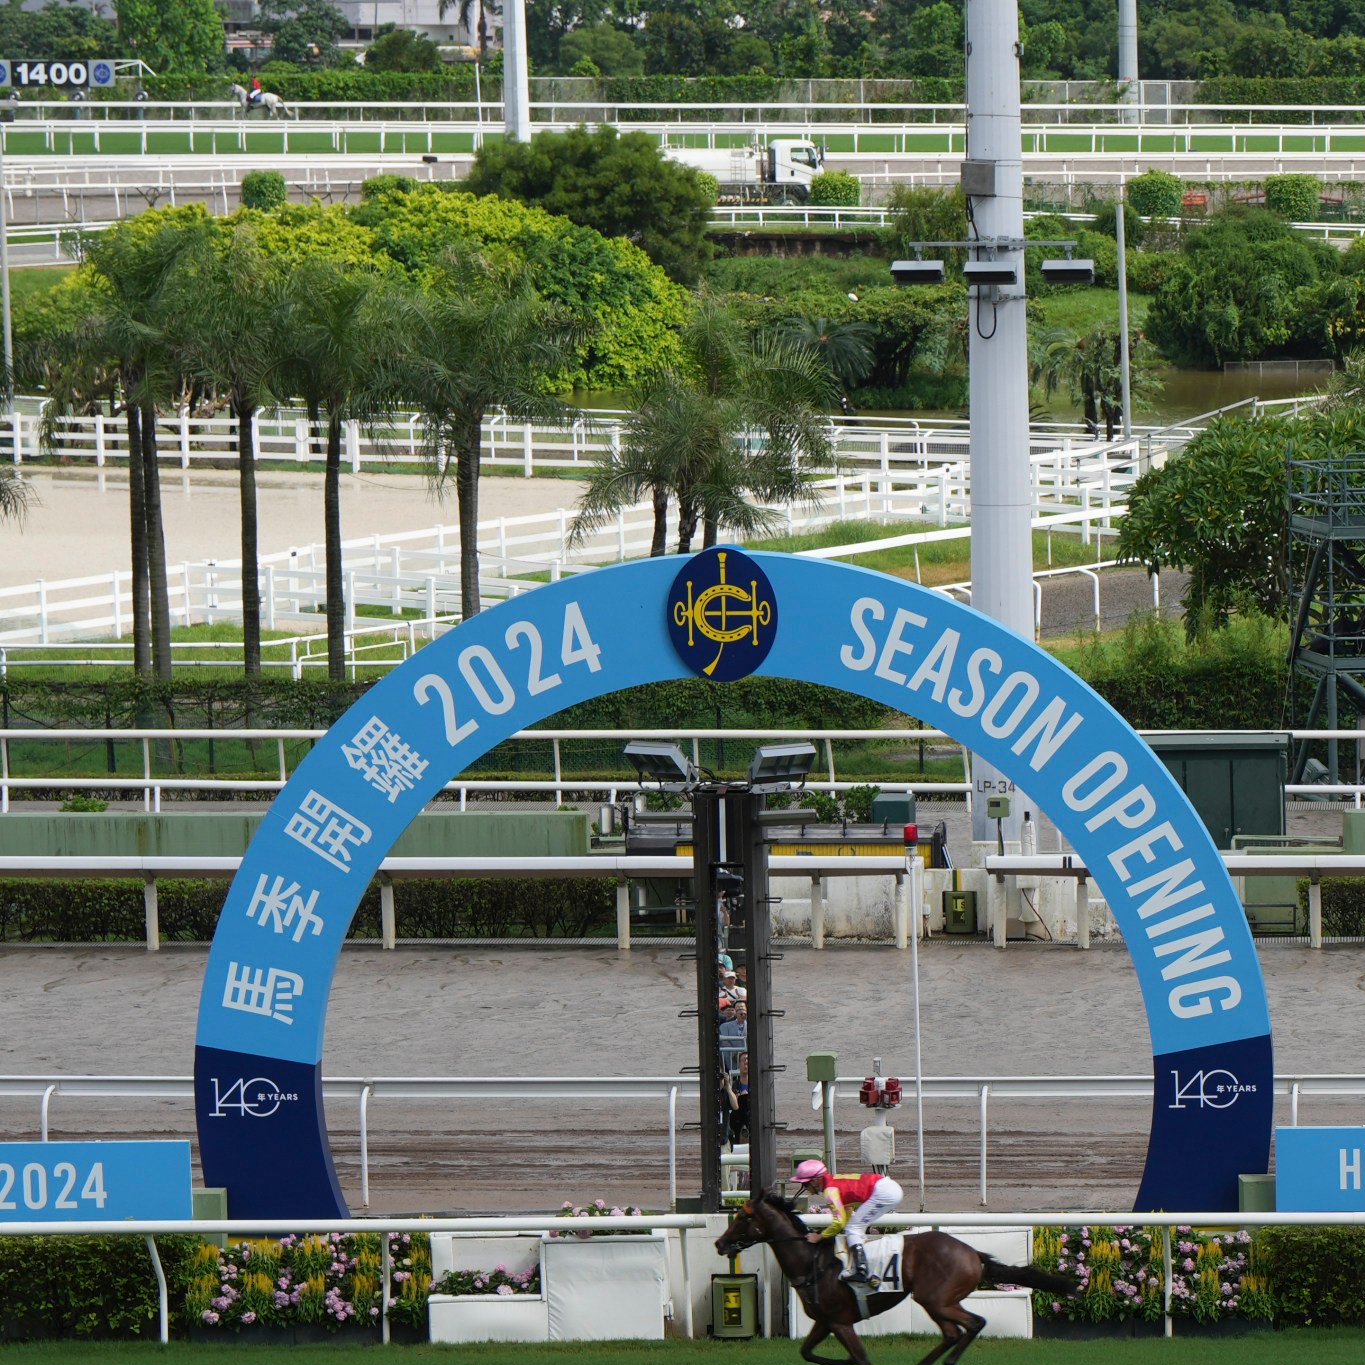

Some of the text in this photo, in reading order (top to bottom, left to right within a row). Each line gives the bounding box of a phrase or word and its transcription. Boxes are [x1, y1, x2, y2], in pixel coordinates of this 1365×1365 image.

[16, 62, 87, 85] 1400
[413, 601, 601, 747] 2024
[977, 779, 1016, 793] LP-34
[840, 597, 1242, 1019] SEASON OPENING
[208, 1077, 280, 1117] 140
[267, 1092, 298, 1101] YEARS
[1168, 1069, 1239, 1109] 140
[1226, 1084, 1257, 1093] YEARS
[0, 1162, 107, 1210] 2024
[882, 1253, 900, 1291] 4
